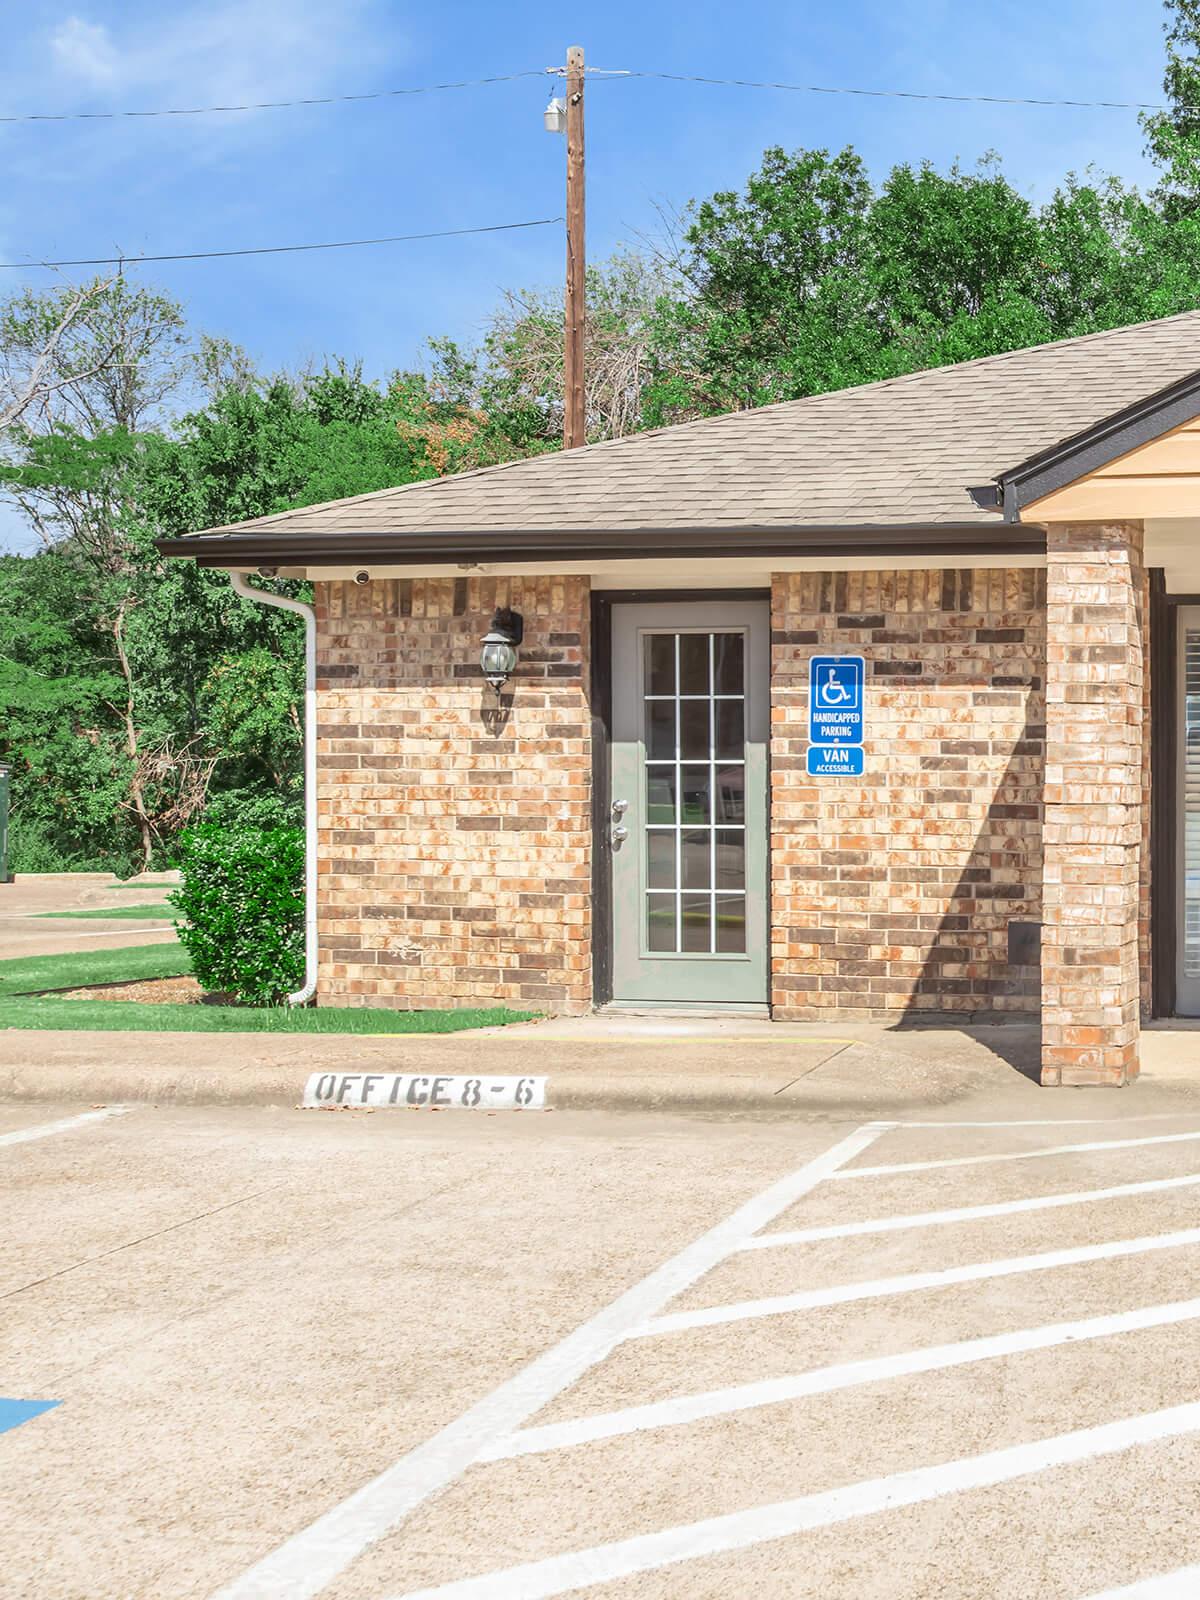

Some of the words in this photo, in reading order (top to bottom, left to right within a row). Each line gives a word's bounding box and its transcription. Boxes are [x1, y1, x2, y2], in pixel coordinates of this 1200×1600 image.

[813, 712, 860, 723] HANDICAPPED
[821, 726, 852, 737] PARKING
[823, 749, 849, 762] VAN
[816, 764, 855, 772] ACCESSIBLE
[315, 1074, 454, 1105] OFFICE
